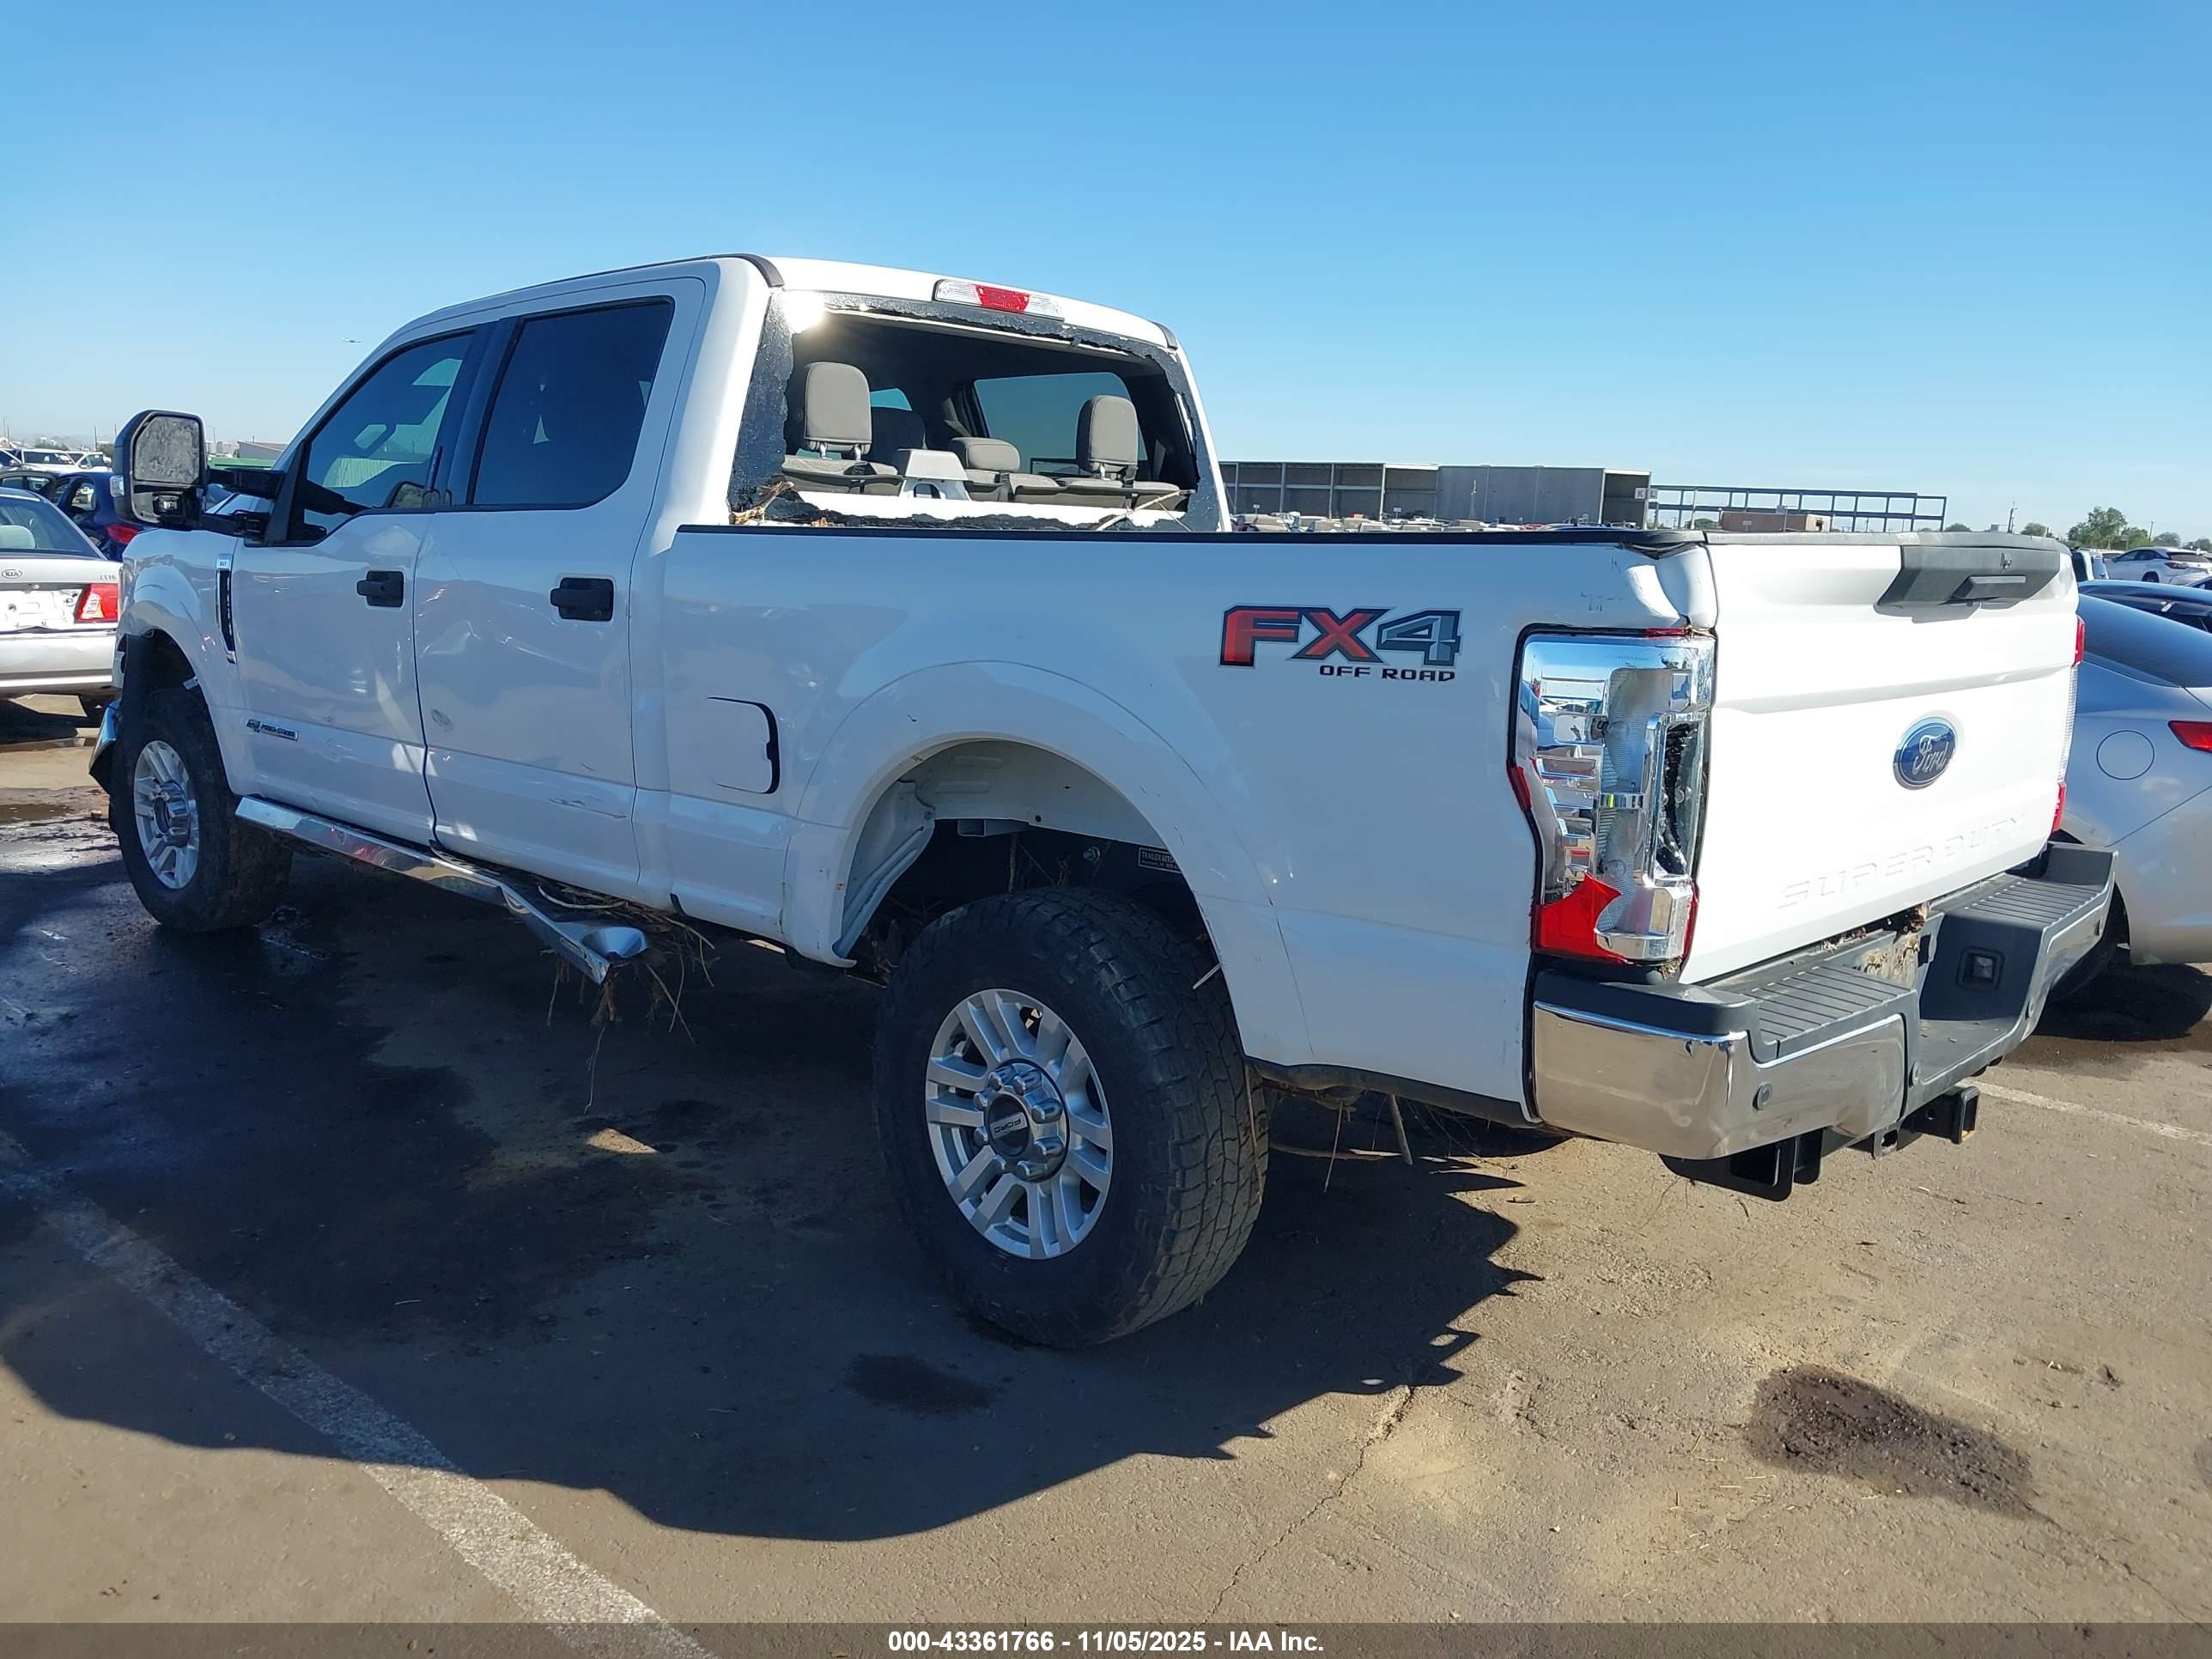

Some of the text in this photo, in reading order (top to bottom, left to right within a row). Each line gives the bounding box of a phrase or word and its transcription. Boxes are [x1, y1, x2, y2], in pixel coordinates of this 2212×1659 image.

[1219, 605, 1462, 667] FX4
[1319, 665, 1455, 683] OFF ROAD
[1911, 733, 1950, 775] Ford
[1141, 851, 1161, 861] TRAILER
[1777, 813, 2027, 910] SUPER DUTY
[994, 1118, 1022, 1133] FORD
